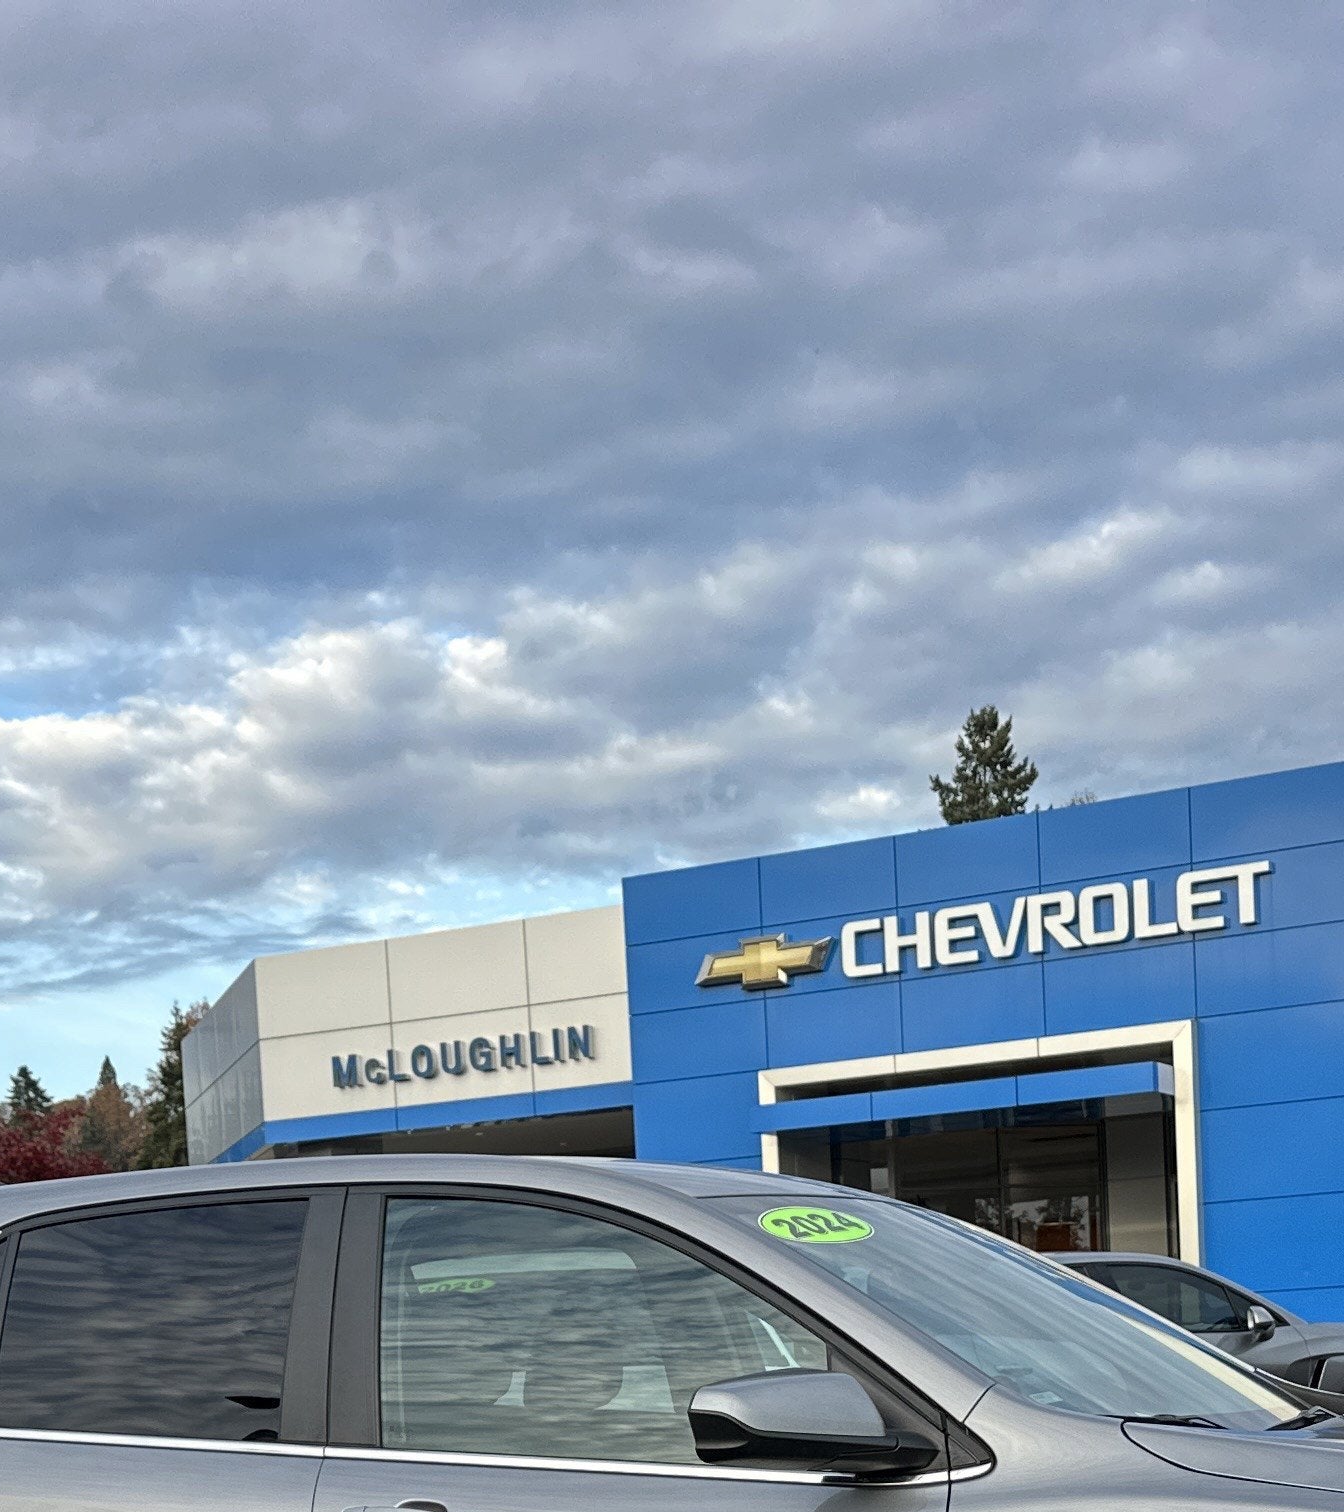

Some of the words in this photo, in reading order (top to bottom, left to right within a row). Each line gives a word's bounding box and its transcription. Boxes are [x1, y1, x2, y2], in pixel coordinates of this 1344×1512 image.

[841, 859, 1270, 978] CHEVROLET
[331, 1024, 595, 1089] McLOUGHLIN
[770, 1212, 866, 1238] 2024
